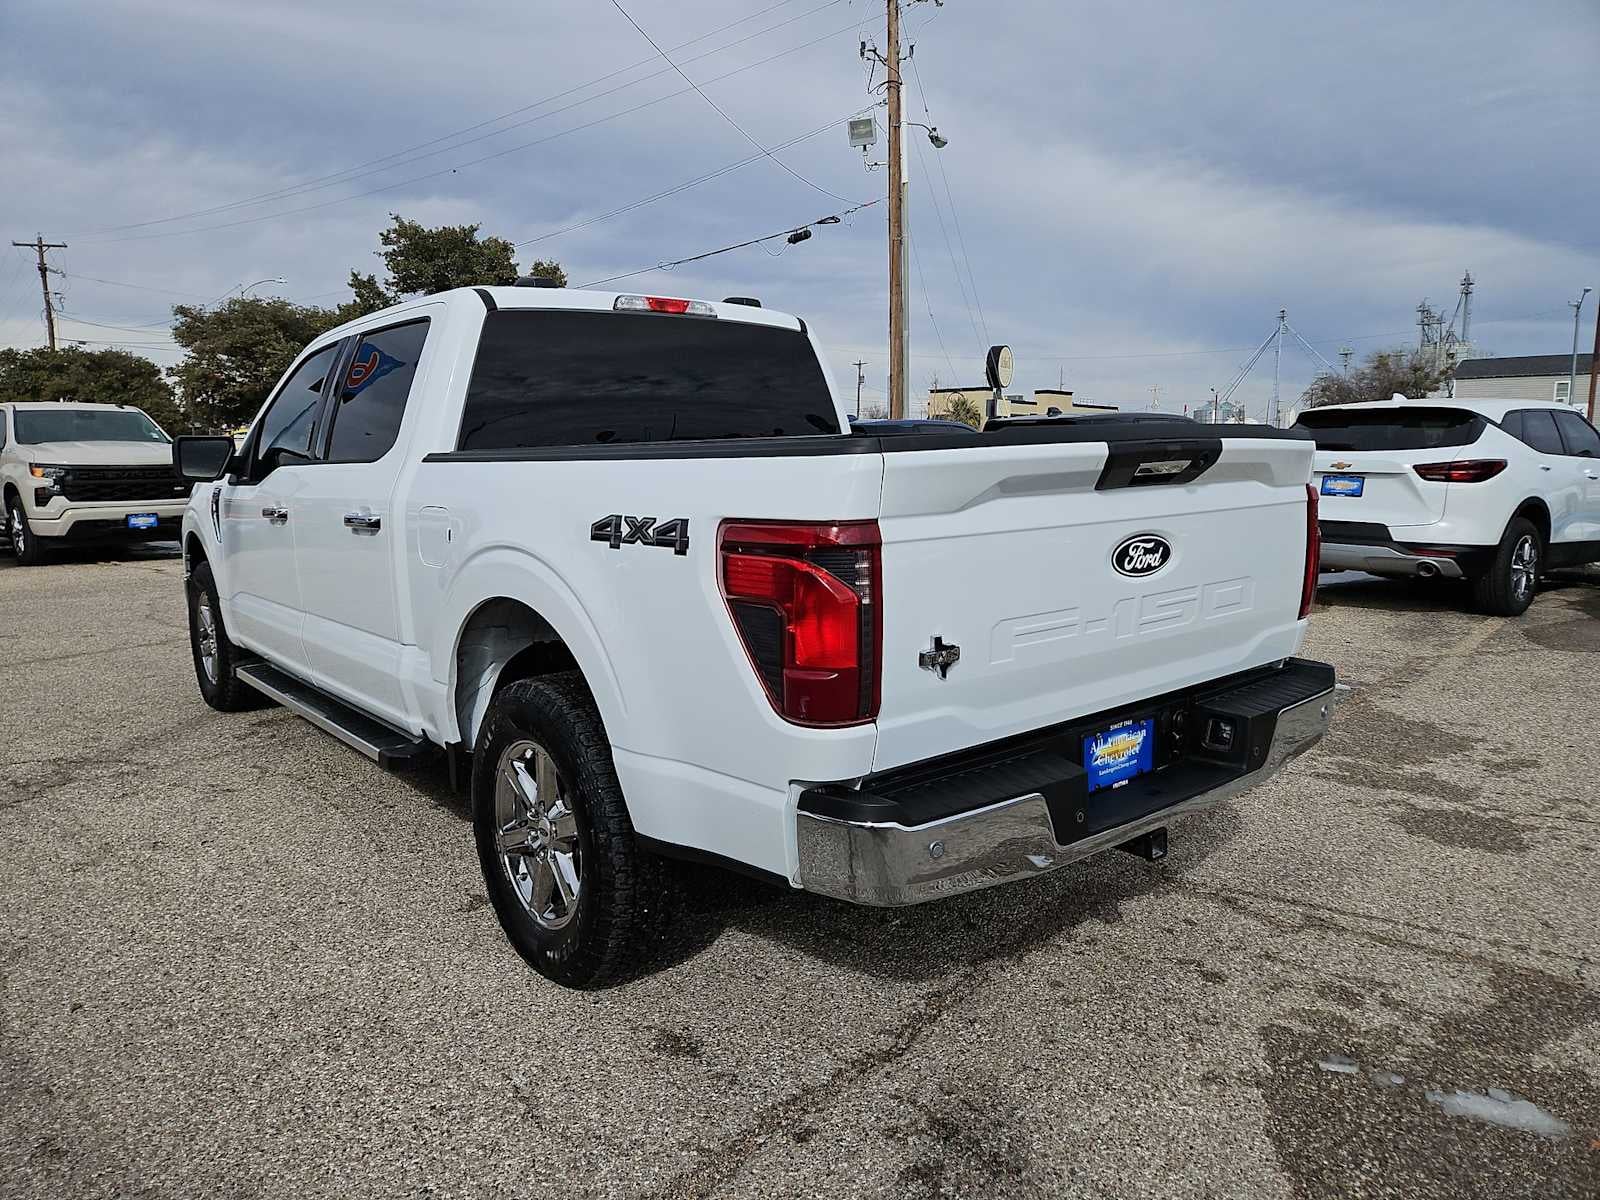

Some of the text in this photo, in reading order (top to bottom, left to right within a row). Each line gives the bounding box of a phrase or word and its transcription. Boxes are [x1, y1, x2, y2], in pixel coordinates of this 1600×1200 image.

[1124, 541, 1164, 571] Ford
[988, 575, 1256, 665] F-150
[1090, 737, 1104, 754] All
[1097, 744, 1140, 766] Chevrolet
